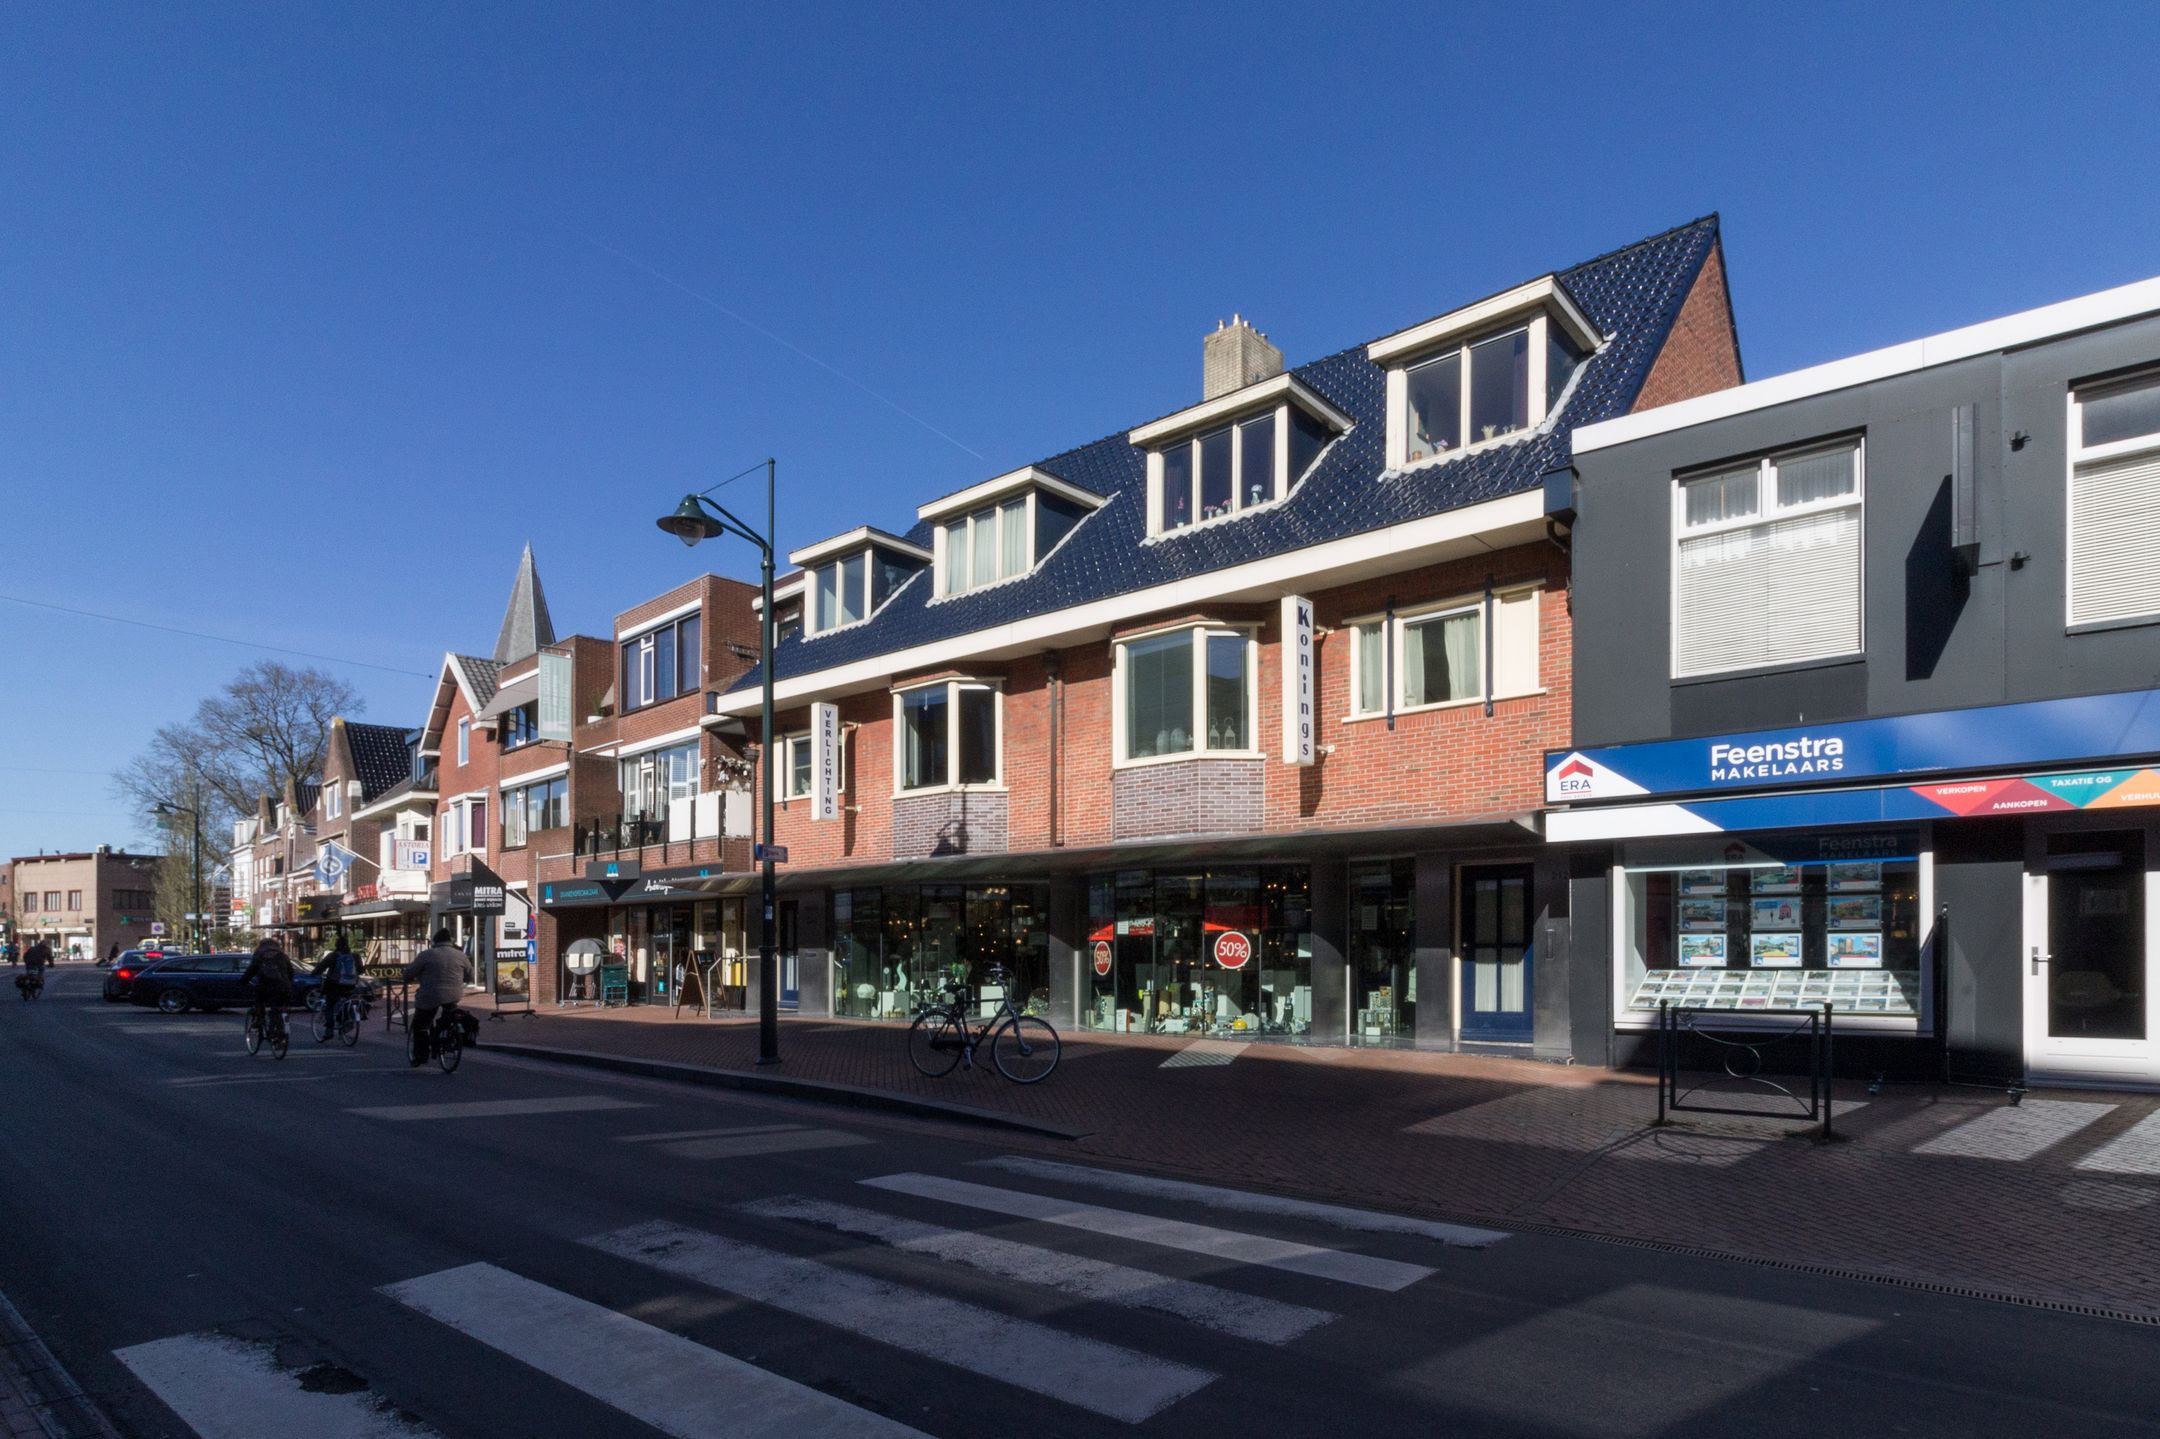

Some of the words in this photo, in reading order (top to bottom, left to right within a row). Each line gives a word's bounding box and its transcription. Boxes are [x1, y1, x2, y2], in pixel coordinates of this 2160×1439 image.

[1297, 605, 1310, 756] Konings
[1711, 736, 1844, 767] Feenstra
[824, 710, 832, 815] VERLICHTING
[1711, 757, 1844, 781] MAKELAARS
[1560, 779, 1592, 792] ERA
[2051, 776, 2093, 787] TAXATIE
[2095, 775, 2113, 784] OG
[1936, 785, 1987, 796] VERKOPEN
[1992, 799, 2048, 810] AANKOPEN
[1818, 835, 1898, 850] Feenstra
[415, 853, 426, 864] P
[474, 886, 503, 895] MITRA
[496, 949, 526, 958] mitra
[1219, 941, 1247, 958] 50%
[1096, 951, 1110, 965] 50%
